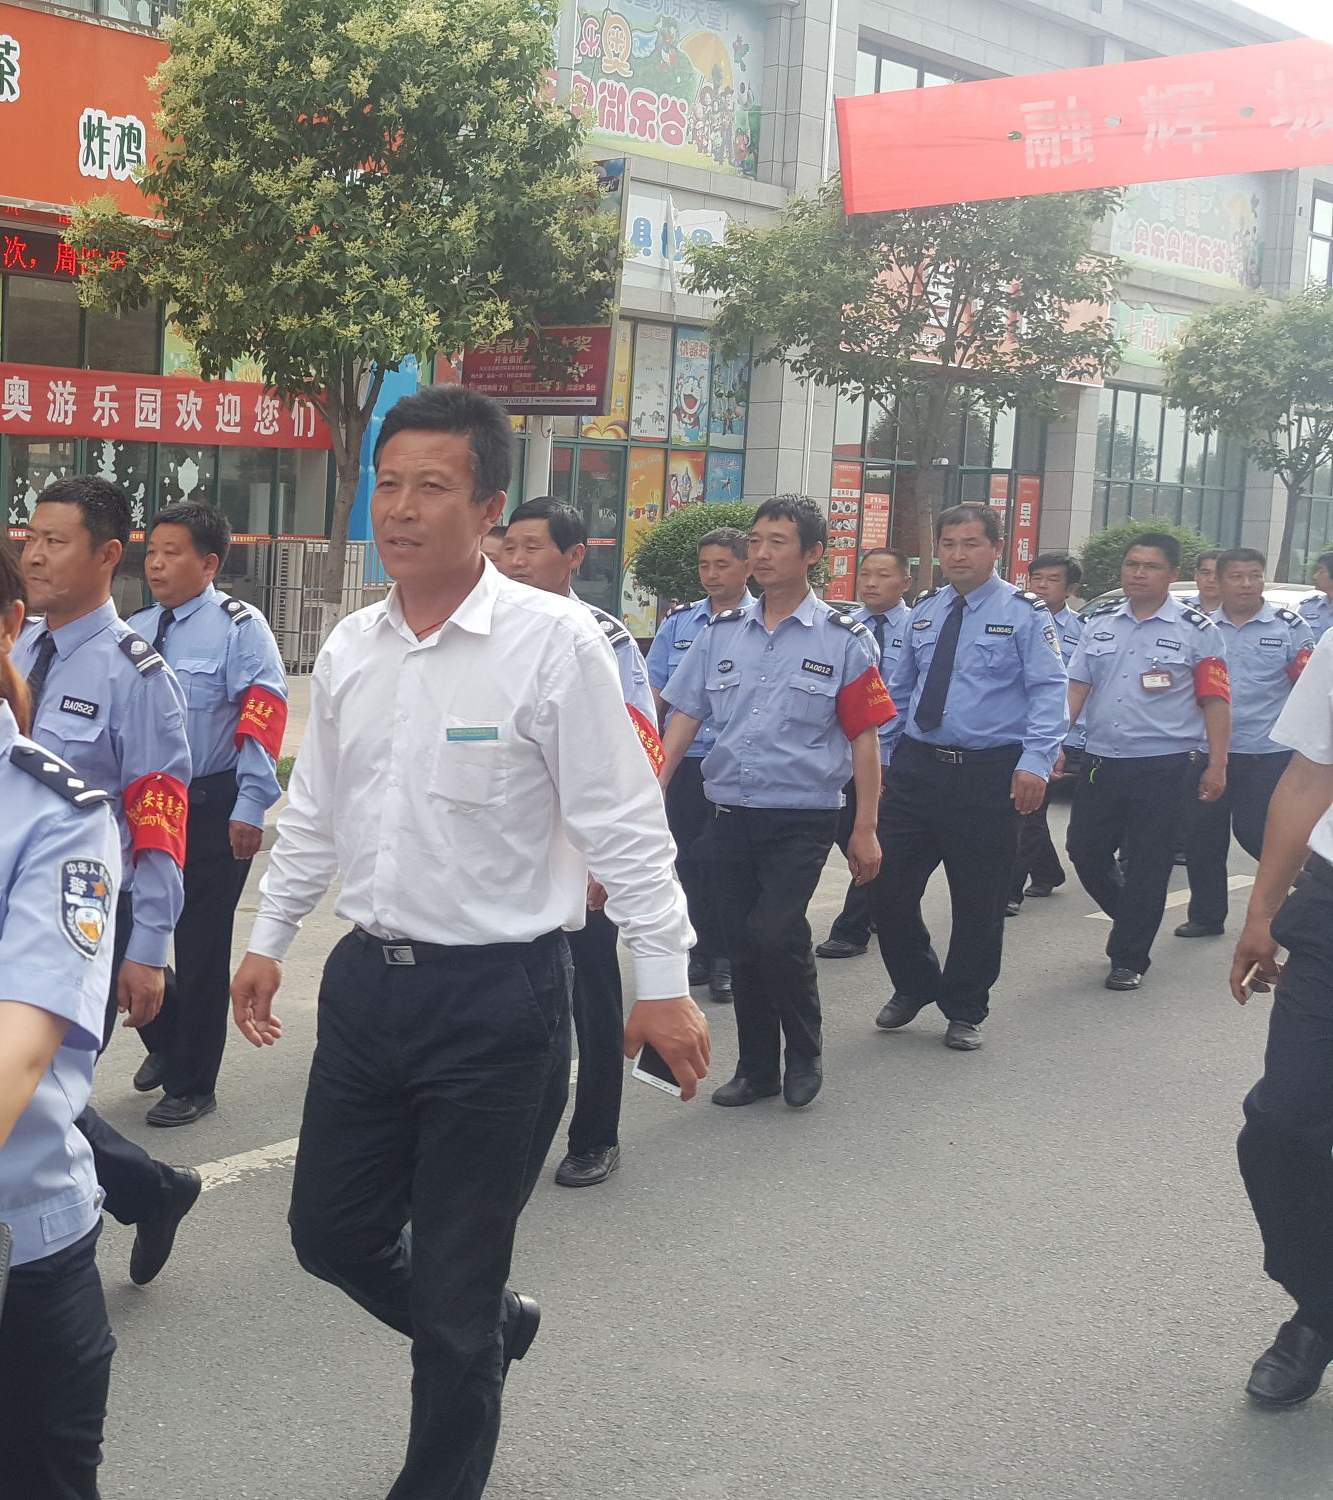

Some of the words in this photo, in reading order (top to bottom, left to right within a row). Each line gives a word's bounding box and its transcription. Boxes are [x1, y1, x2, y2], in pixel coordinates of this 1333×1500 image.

[81, 114, 145, 174] 炸鸡
[804, 661, 831, 675] BA0012
[62, 699, 95, 716] BA0522
